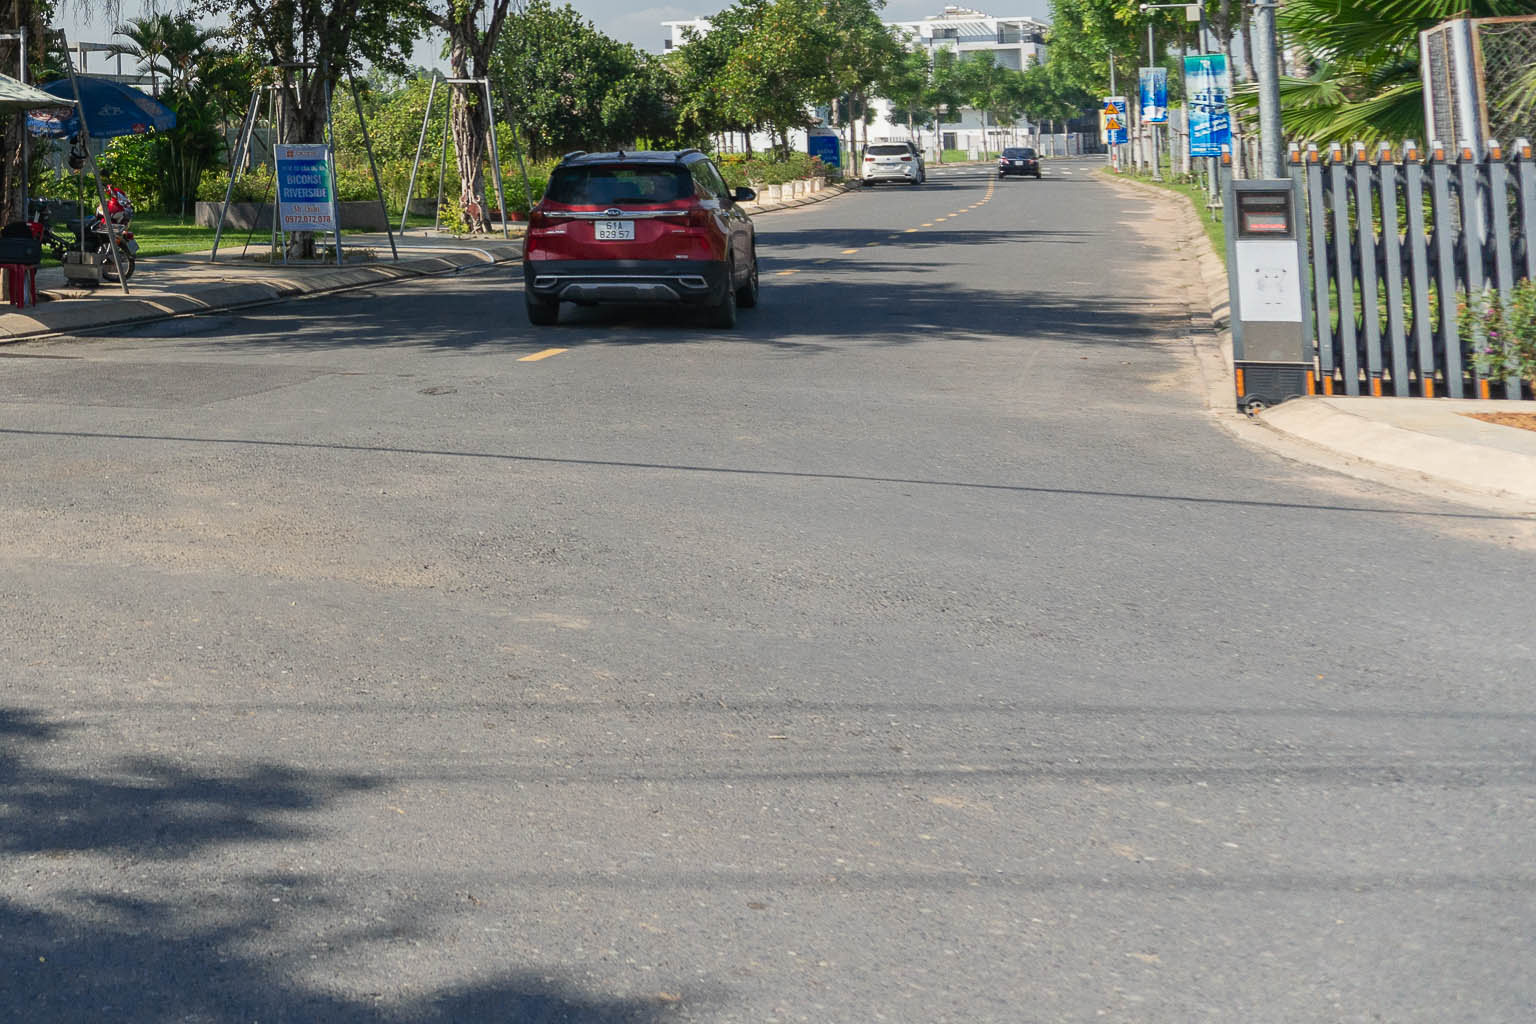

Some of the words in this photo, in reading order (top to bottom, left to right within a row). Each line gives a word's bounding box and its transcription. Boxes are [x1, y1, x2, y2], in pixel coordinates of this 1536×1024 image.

[287, 175, 322, 184] BICONSI
[284, 188, 327, 198] RIVERSIDE
[606, 222, 623, 230] 61A
